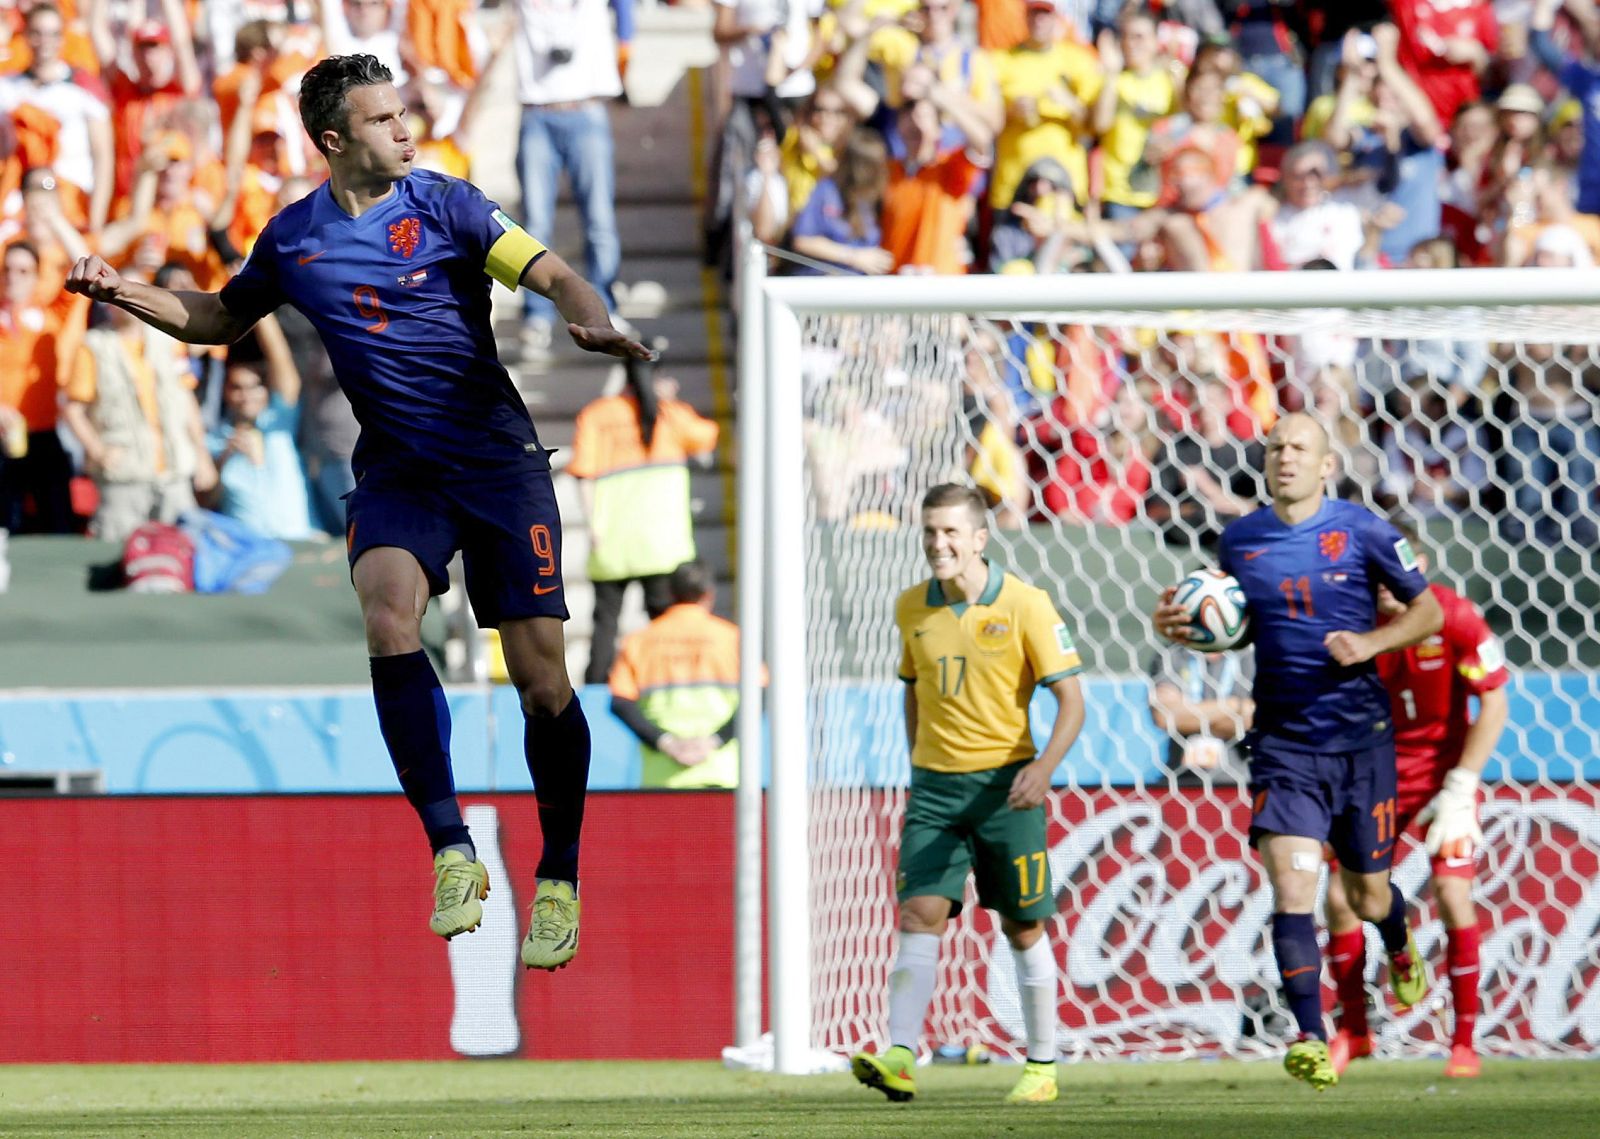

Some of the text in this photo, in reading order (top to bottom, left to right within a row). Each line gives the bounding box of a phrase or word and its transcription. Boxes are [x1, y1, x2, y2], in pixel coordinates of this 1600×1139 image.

[353, 286, 388, 333] 9
[529, 525, 555, 576] 9
[1279, 576, 1314, 619] 11
[937, 656, 967, 695] 17
[1400, 689, 1417, 720] 1
[1371, 798, 1395, 842] 11
[1013, 851, 1046, 896] 17
